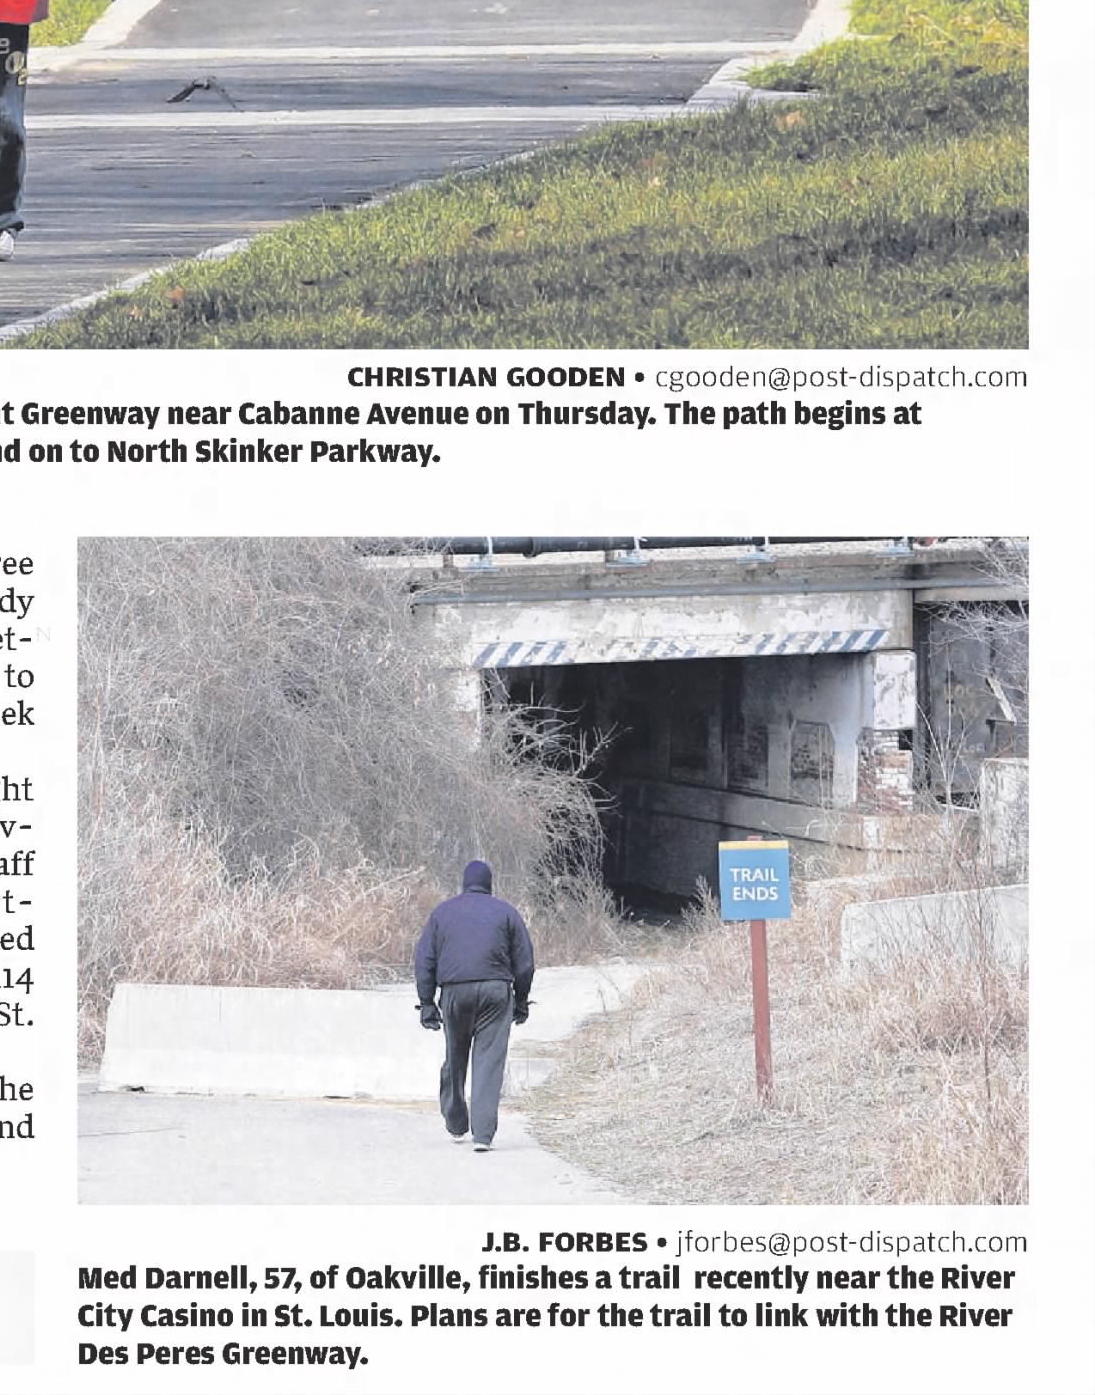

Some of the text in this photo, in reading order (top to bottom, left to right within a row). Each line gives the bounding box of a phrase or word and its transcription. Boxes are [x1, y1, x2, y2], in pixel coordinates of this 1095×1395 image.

[347, 365, 1027, 393] CHRISTIAN GOODEN cgooden@post-dispatch.com
[20, 401, 161, 430] Greenway
[167, 405, 232, 426] near
[238, 400, 360, 426] Cabanne
[365, 402, 470, 426] Avenue
[475, 405, 510, 425] on
[517, 400, 657, 430] Thursday.
[663, 400, 716, 426] The
[723, 400, 787, 430] path
[794, 399, 886, 431] begins
[893, 401, 923, 426] at
[28, 443, 63, 463] on
[69, 438, 100, 463] to
[107, 437, 188, 463] North
[195, 437, 304, 464] Skinker
[310, 437, 441, 468] Parkway.
[730, 867, 779, 882] TRAIL
[733, 886, 779, 901] ENDS
[481, 1229, 1027, 1258] J.B. FORBES jforbes@post-dispatch.com
[78, 1263, 1016, 1295] Med Darnell, 57, of Oakville, finishes a trail recently near the River
[77, 1301, 1014, 1333] City Casino in St. Louis. Plans are for the trail to link with the River
[78, 1341, 369, 1370] Des Peres Greenway.
